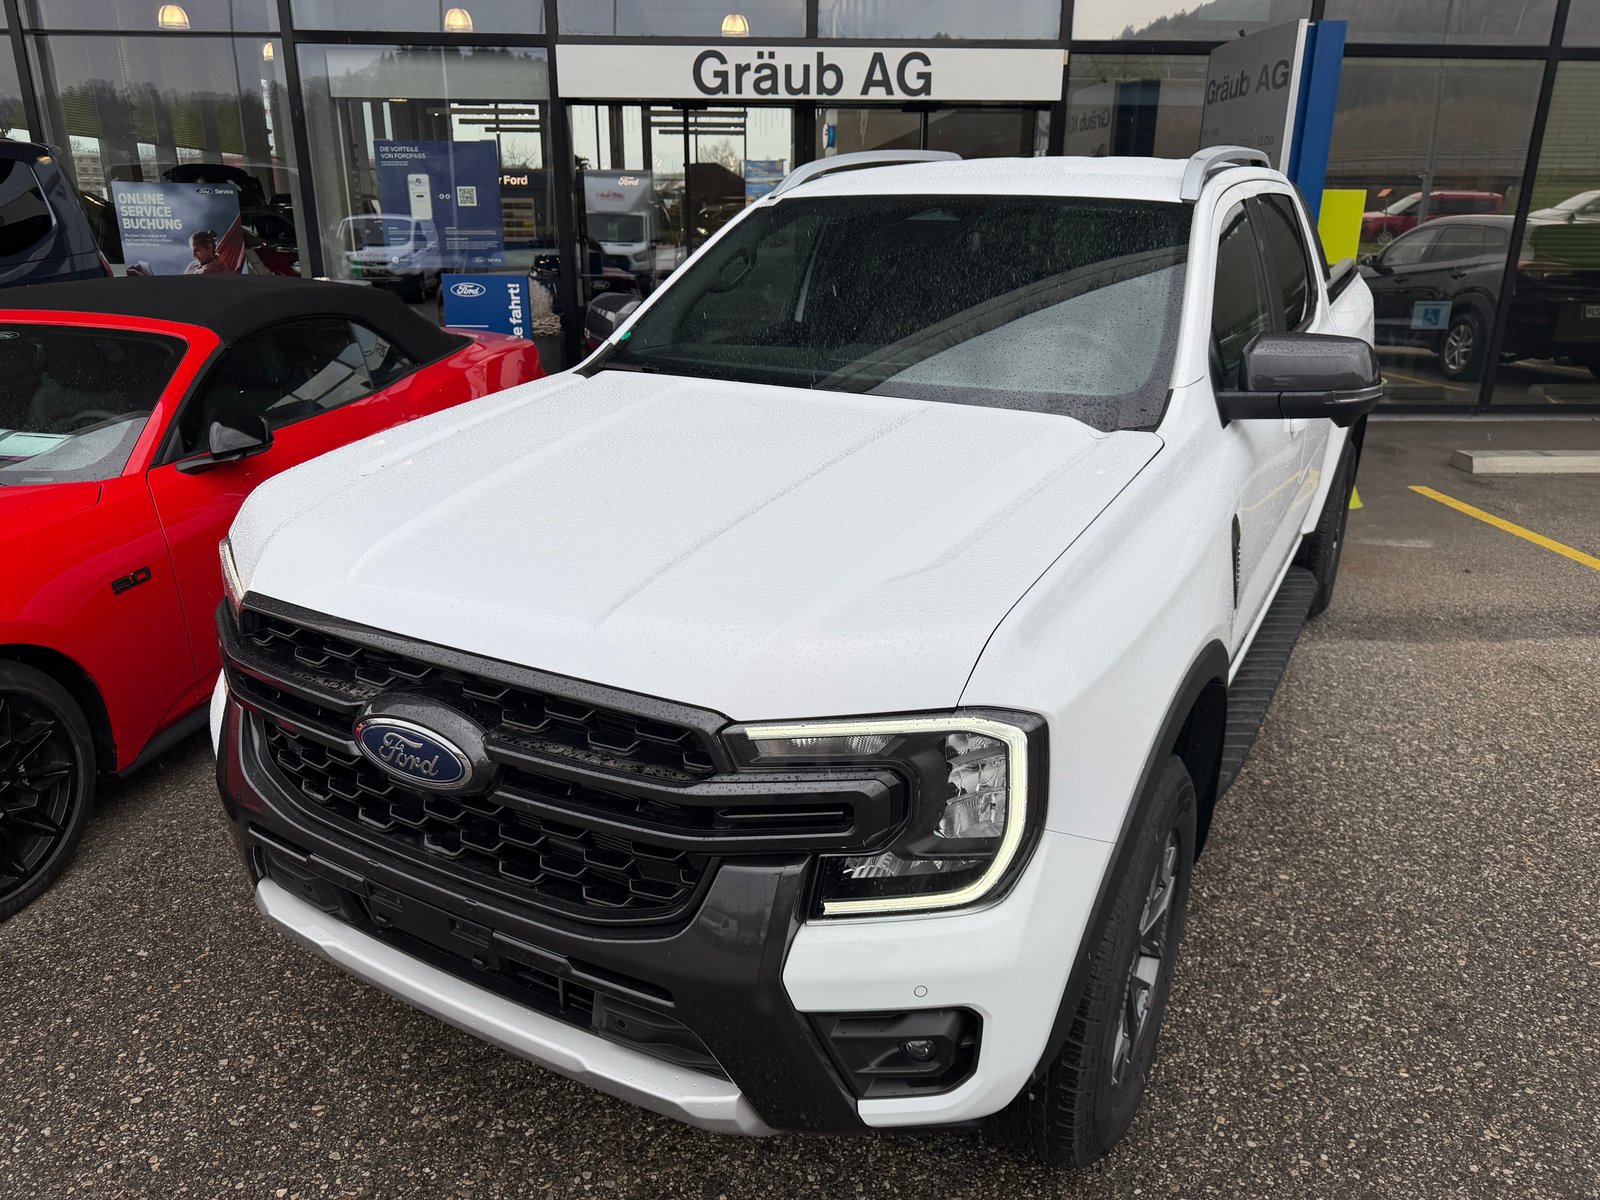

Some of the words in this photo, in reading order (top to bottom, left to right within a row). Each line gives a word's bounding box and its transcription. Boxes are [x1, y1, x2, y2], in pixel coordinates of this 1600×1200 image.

[692, 50, 844, 96] Gräub
[860, 51, 932, 97] AG
[1207, 69, 1250, 106] Gräub
[1255, 59, 1290, 94] AG
[503, 174, 529, 186] Ford
[617, 175, 640, 187] Ford
[118, 192, 165, 206] ONLINE
[121, 205, 173, 218] SERVICE
[122, 218, 183, 231] BUCHUNG
[507, 283, 523, 325] fahrt!
[379, 732, 440, 777] Ford
